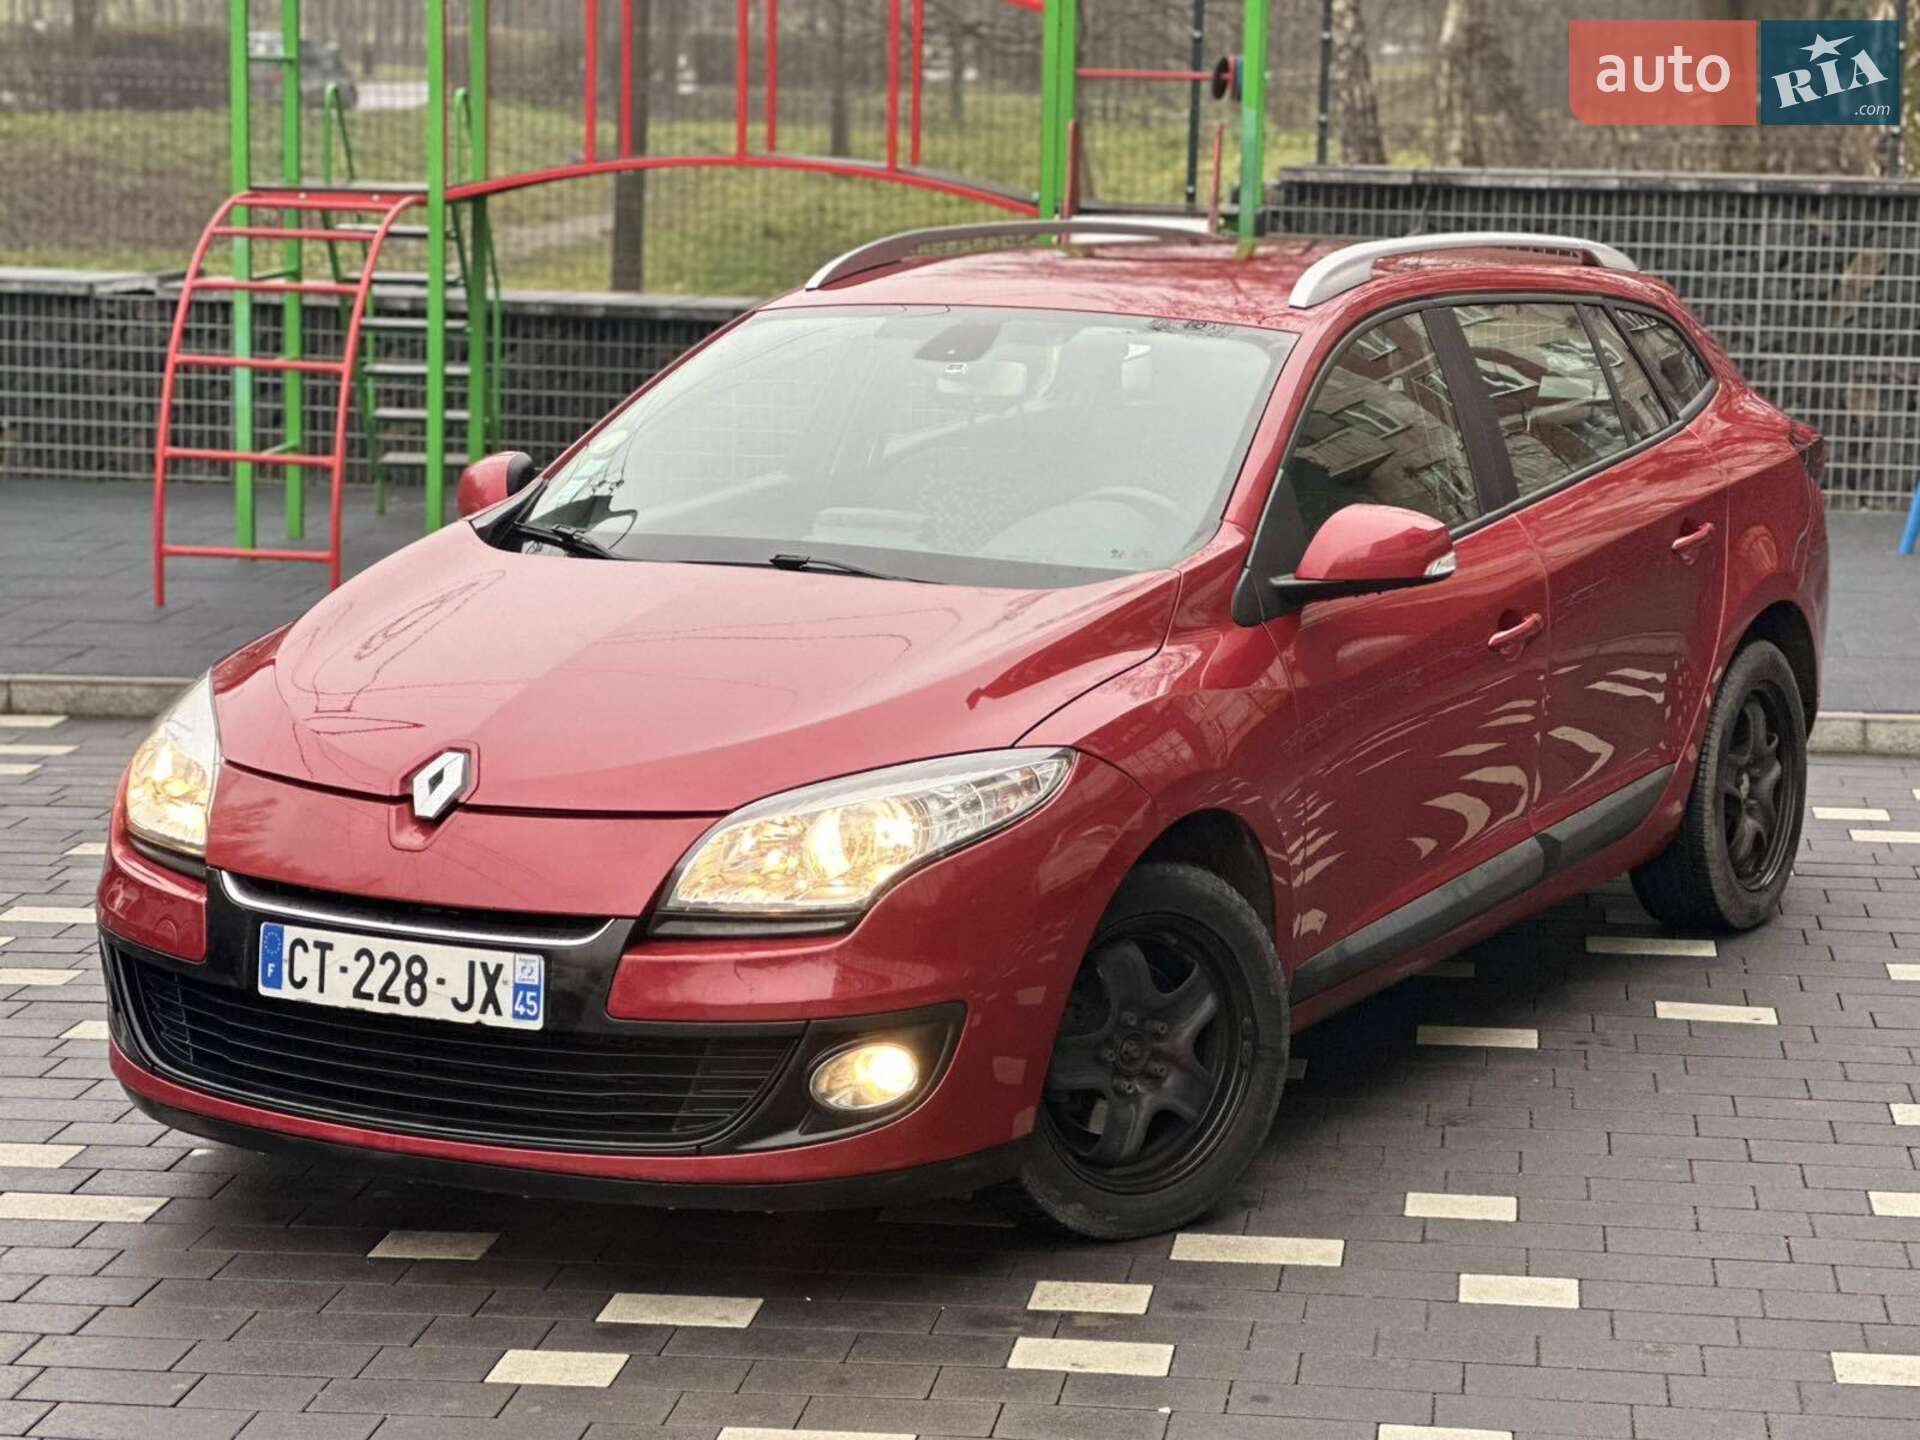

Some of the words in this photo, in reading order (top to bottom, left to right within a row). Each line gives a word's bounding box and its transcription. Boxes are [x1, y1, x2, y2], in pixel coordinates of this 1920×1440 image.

[267, 962, 276, 978] F
[287, 937, 504, 1017] CT-228-JX
[514, 990, 538, 1016] 45
